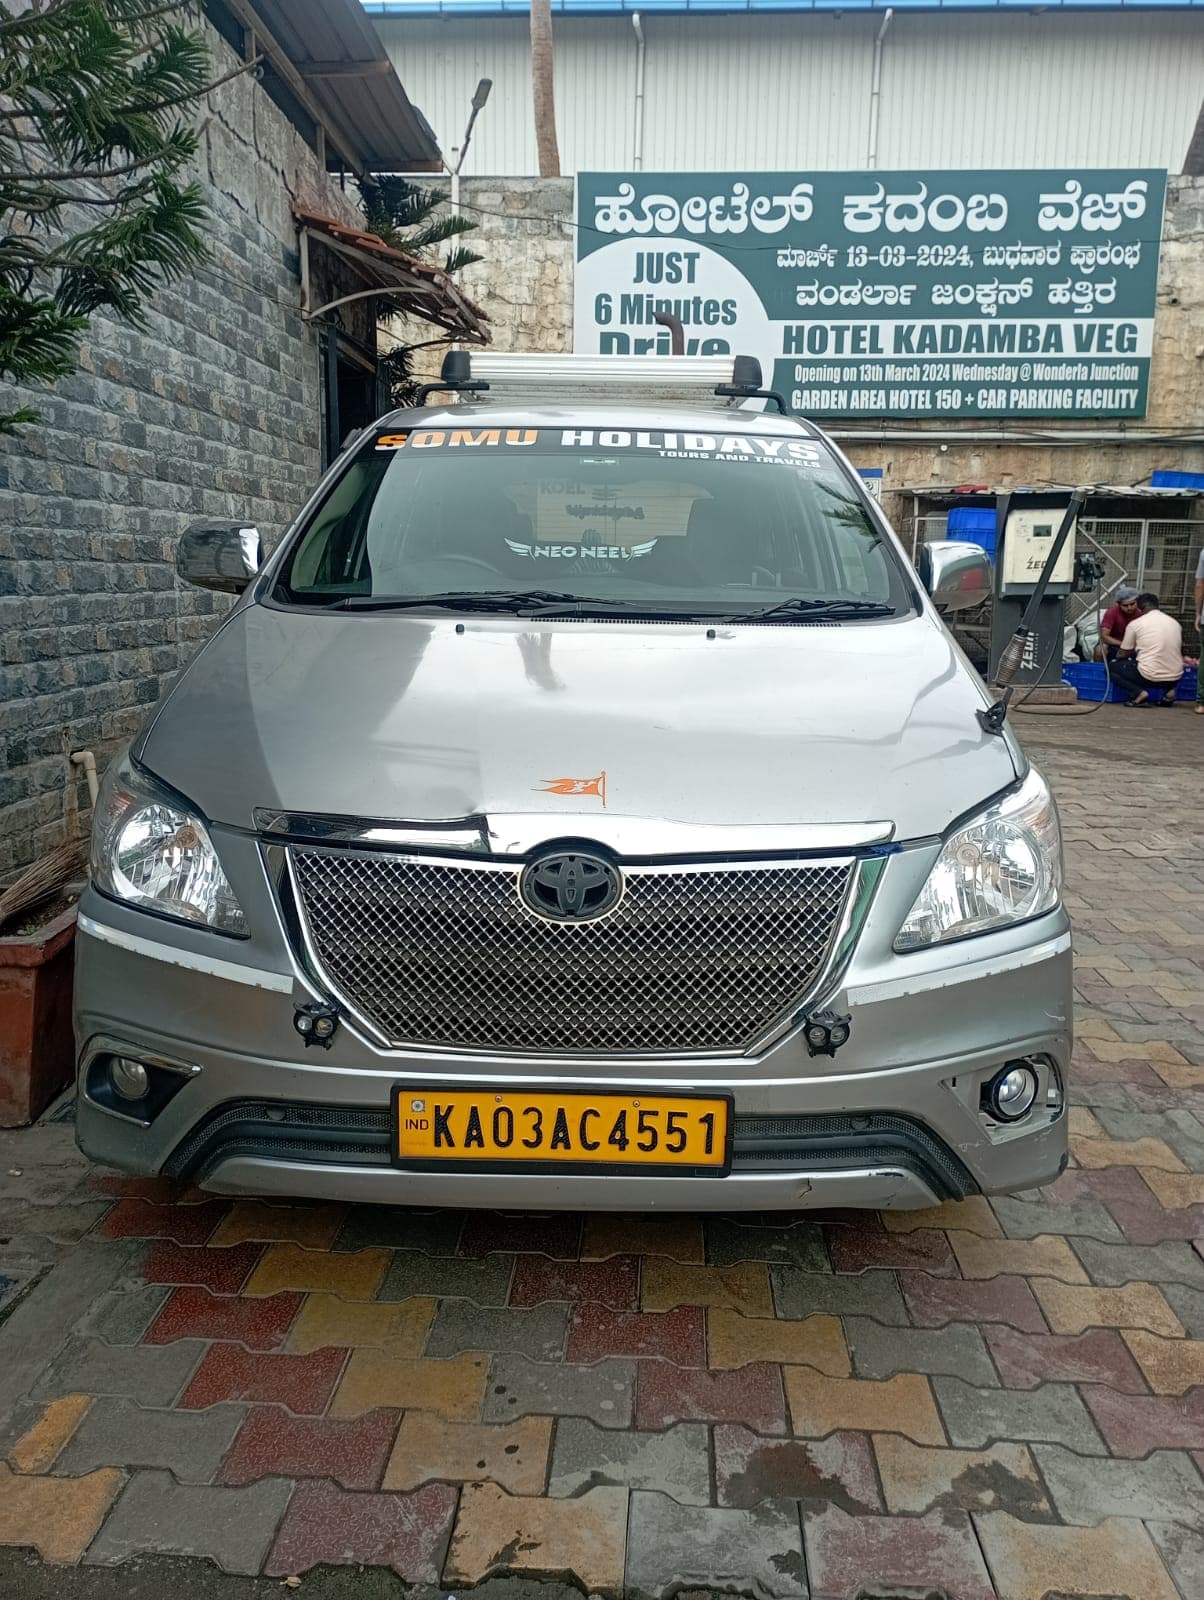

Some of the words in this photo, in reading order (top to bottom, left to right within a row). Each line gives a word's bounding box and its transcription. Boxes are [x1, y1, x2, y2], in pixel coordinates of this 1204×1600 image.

[594, 182, 814, 235] ಹೋಟೆಲ್
[842, 181, 1009, 234] ಕದಂಬ
[1037, 180, 1149, 232] ವೆಜ್
[633, 252, 700, 284] JUST
[776, 243, 838, 268] ಮಾರ್ಚ್
[846, 244, 974, 269] 13-03-2024,
[1070, 238, 1141, 274] ಪ್ರಾರಂಭ
[594, 293, 613, 325] 6
[620, 293, 737, 325] Minutes
[796, 278, 917, 306] ವಂಡರ್ಲಾ
[931, 276, 1034, 317] ಜಂಕ್ಷನ್
[1047, 276, 1117, 314] ಹತ್ತಿರ
[782, 324, 884, 355] HOTEL
[892, 323, 1064, 354] KADAMBA
[1073, 322, 1138, 353] VEG
[794, 364, 841, 384] Opening
[842, 367, 858, 382] on
[859, 364, 883, 382] 13th
[884, 364, 921, 382] March
[921, 364, 951, 382] 2024
[951, 363, 1018, 383] Wednesday
[1033, 363, 1089, 381] Wonderla
[1089, 362, 1139, 381] Junction
[791, 389, 848, 410] GARDEN
[849, 389, 887, 410] AREA
[888, 389, 933, 410] HOTEL
[934, 388, 963, 410] 150
[977, 388, 1008, 410] CAR
[1009, 388, 1073, 409] PARKING
[1074, 388, 1139, 409] FACILITY
[374, 429, 539, 451] SOMU
[561, 430, 820, 461] HOLIDAYS
[658, 450, 710, 459] TOURS
[714, 453, 749, 462] AND
[755, 456, 821, 468] TRAVELS
[533, 545, 577, 558] NEO
[580, 545, 630, 559] NEEL
[405, 1119, 429, 1130] IND
[433, 1104, 716, 1154] KA03AC4551
